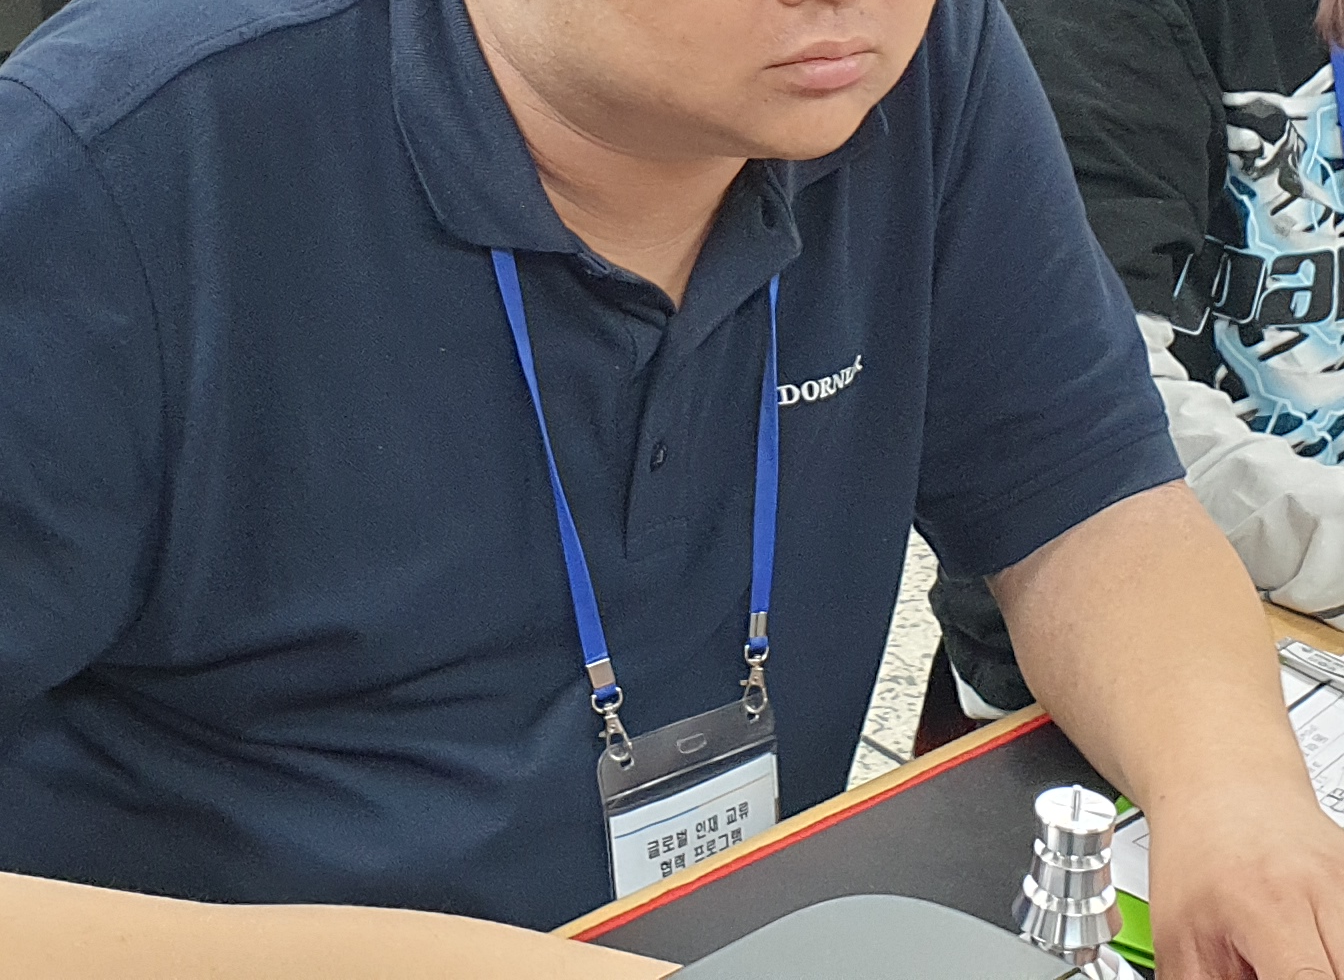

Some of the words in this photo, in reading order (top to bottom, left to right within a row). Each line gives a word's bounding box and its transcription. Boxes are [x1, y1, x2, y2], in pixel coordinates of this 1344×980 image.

[695, 814, 719, 840] 인재
[725, 800, 750, 826] 교류
[660, 852, 686, 878] 협력
[693, 827, 744, 864] 프로그램
